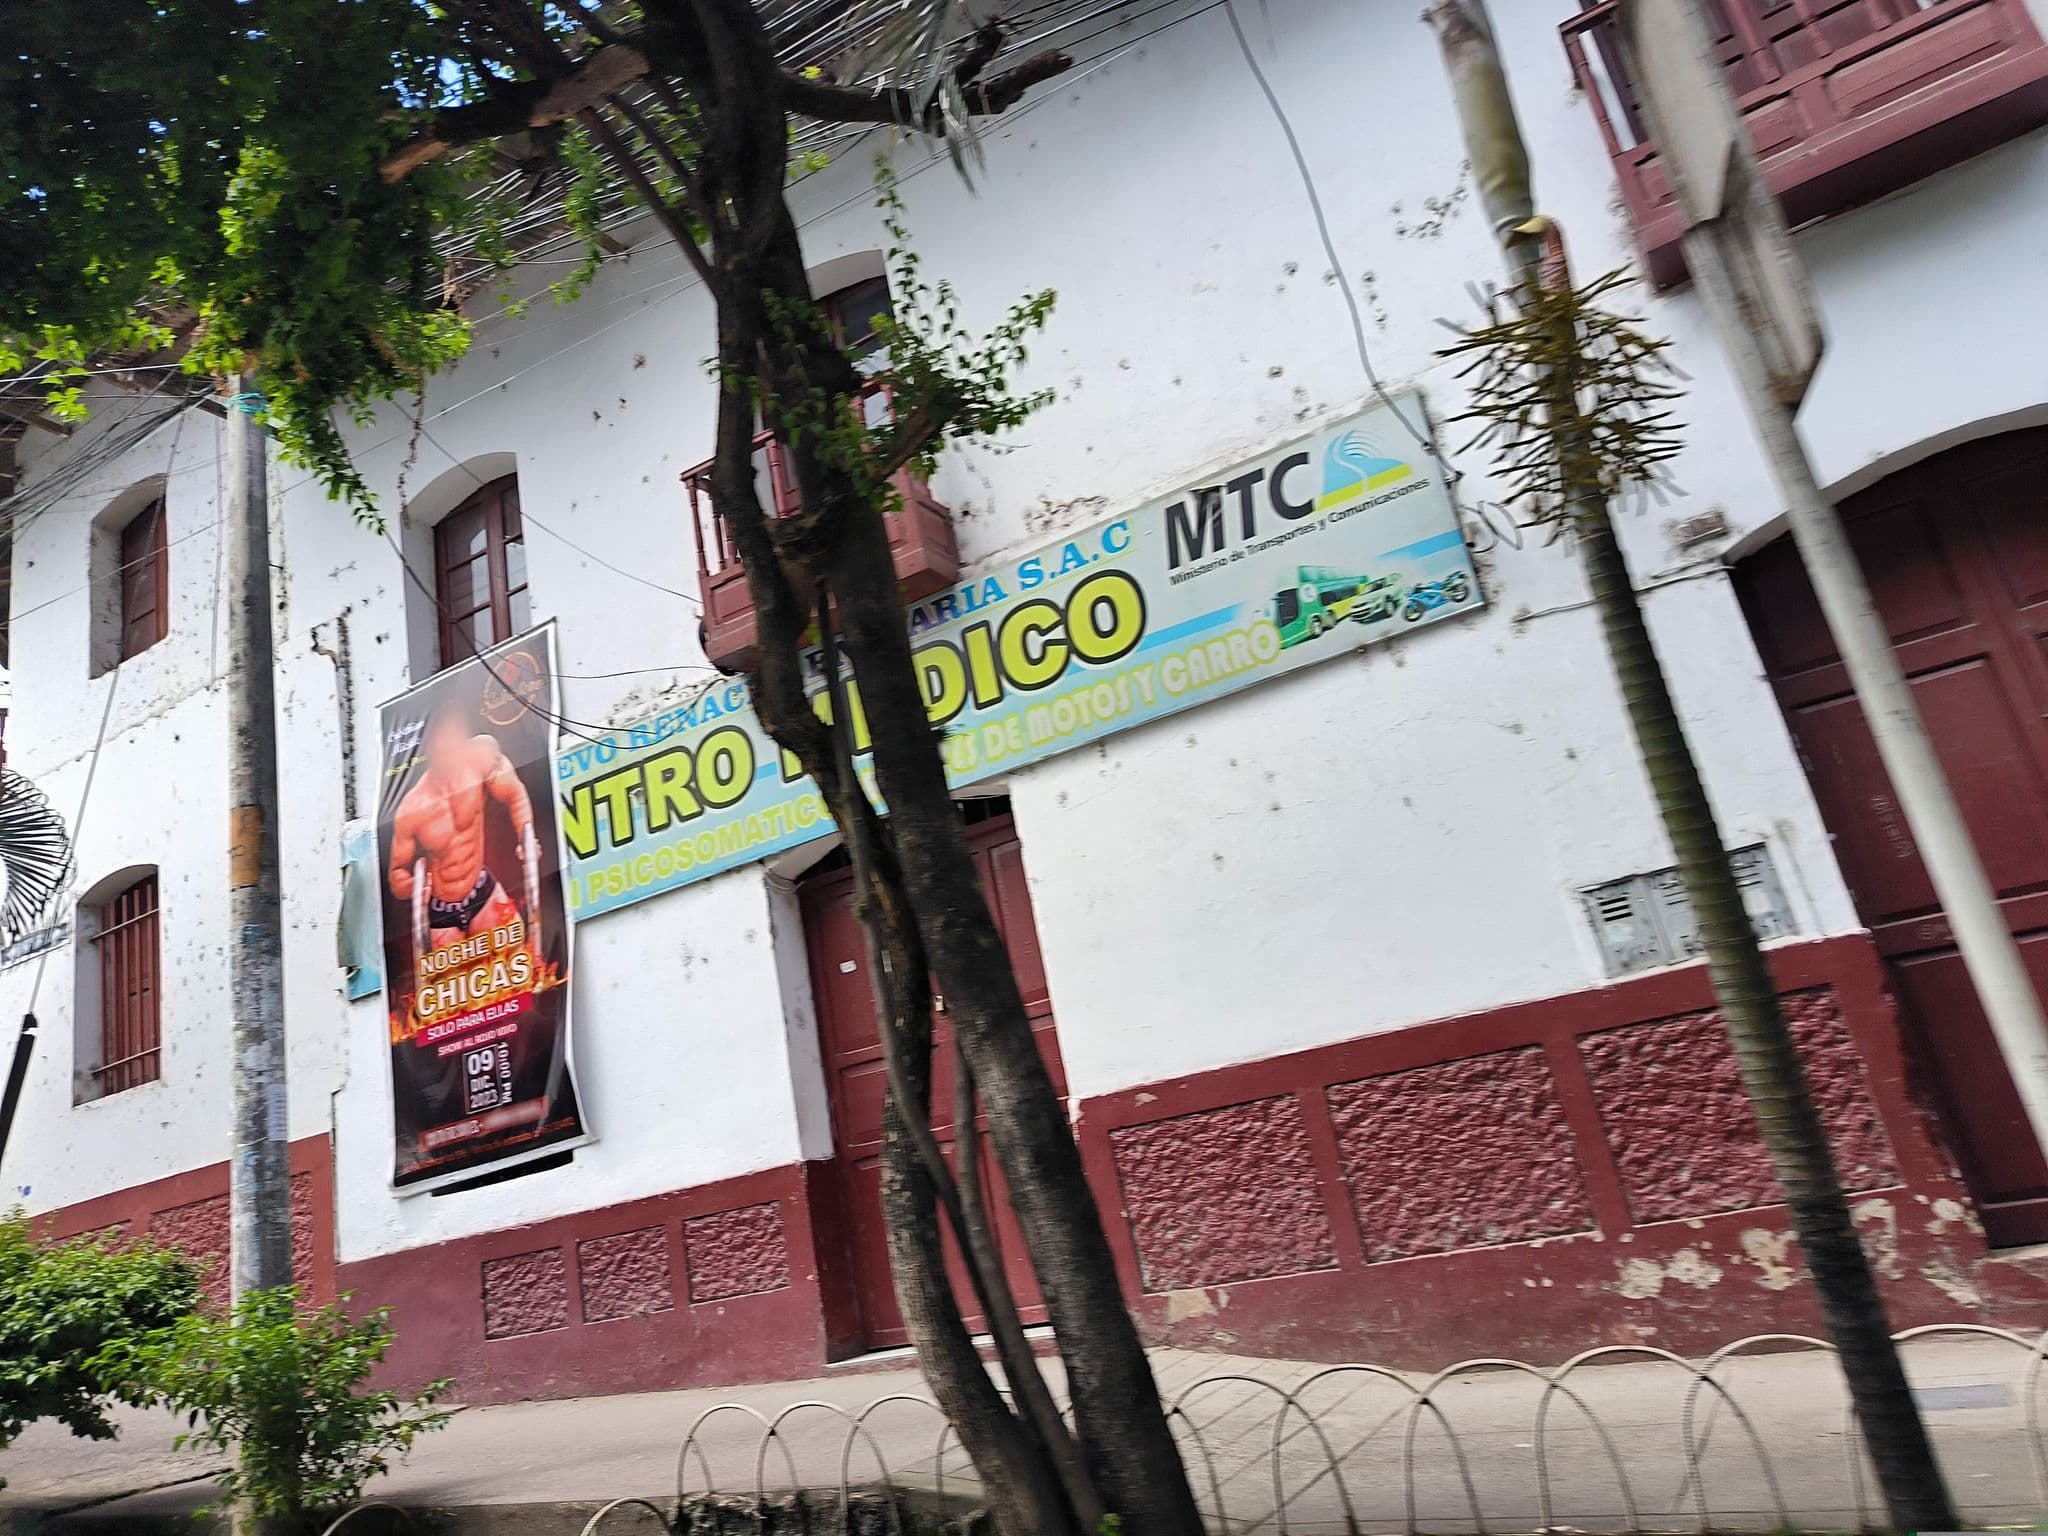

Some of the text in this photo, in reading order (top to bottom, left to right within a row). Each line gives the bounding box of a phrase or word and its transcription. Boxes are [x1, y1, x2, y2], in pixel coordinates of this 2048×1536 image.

[1165, 452, 1314, 570] MTC
[1170, 479, 1430, 587] Ministerio de Transportes y Comunicaciones
[628, 682, 752, 752] RENAC
[1018, 520, 1132, 591] S.A.C
[780, 569, 1146, 785] DICO
[983, 711, 1030, 763] DE
[1028, 679, 1131, 746] MOTOS
[1134, 667, 1157, 706] Y
[1162, 621, 1282, 696] CARRO
[420, 921, 524, 976] NOCHE DE
[416, 953, 532, 1018] CHICAS
[428, 999, 519, 1040] SOLO PARA ELLAS
[467, 1049, 495, 1075] 09
[497, 1041, 513, 1105] 10:00 PM
[470, 1089, 499, 1109] 2023
